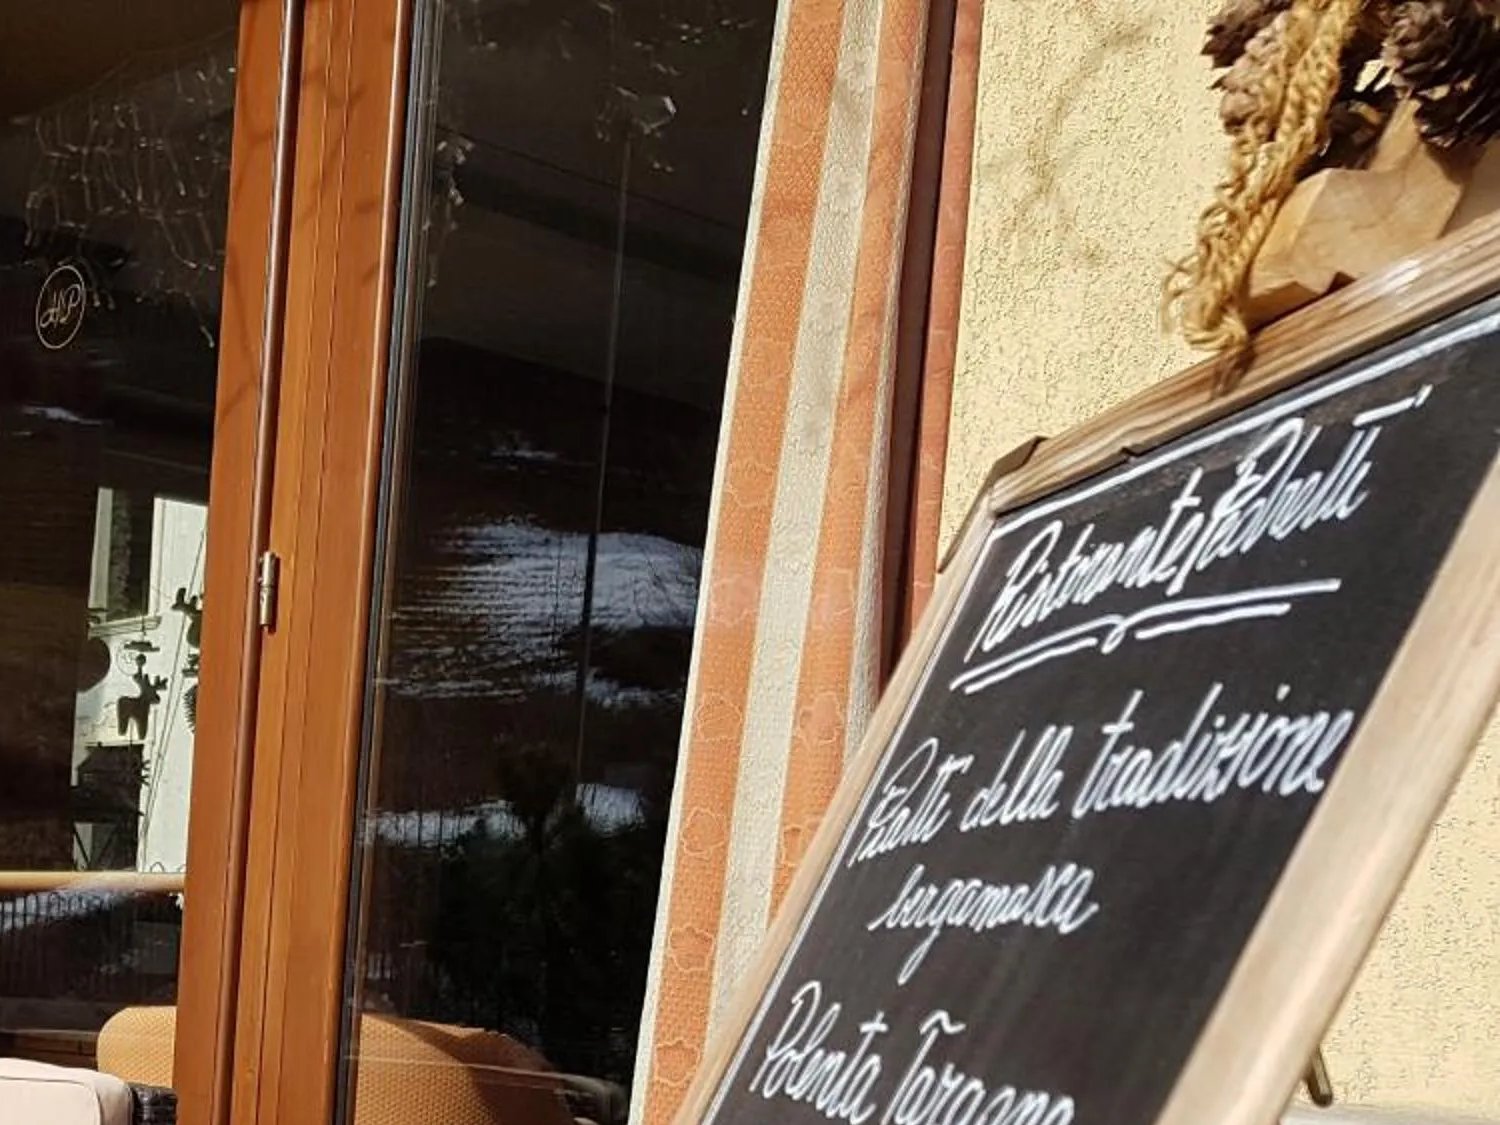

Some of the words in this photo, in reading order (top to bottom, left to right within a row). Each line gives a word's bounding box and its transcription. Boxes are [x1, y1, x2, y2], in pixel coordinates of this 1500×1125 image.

[963, 468, 1202, 663] Ristorante
[1167, 385, 1432, 596] Pedretti
[848, 737, 973, 868] Piatti
[959, 725, 1073, 833] della
[1073, 683, 1354, 818] tradizione
[868, 863, 1100, 985] bergamasca
[749, 980, 888, 1125] Polenta
